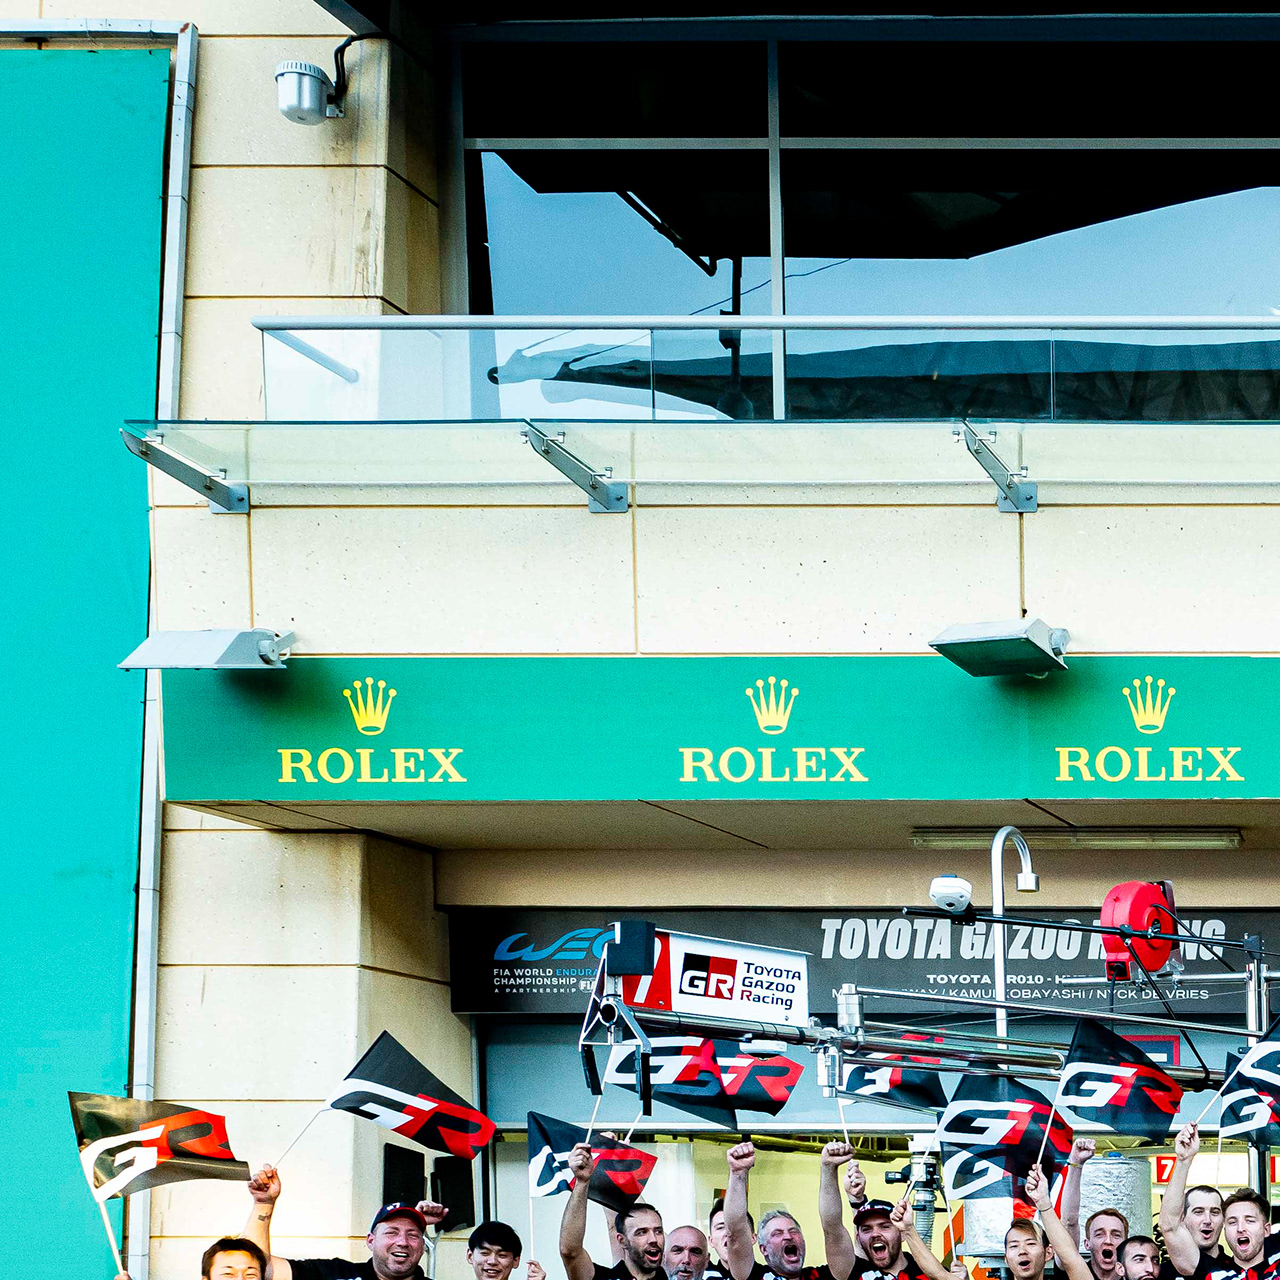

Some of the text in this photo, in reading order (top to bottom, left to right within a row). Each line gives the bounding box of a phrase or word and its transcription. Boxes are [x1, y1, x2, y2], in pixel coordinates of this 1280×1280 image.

[279, 748, 461, 783] ROLEX
[683, 748, 865, 783] ROLEX
[1057, 747, 1239, 782] ROLEX
[820, 918, 950, 960] TOYOTA
[744, 961, 801, 980] TOYOTA
[926, 974, 991, 985] TOYOTA
[494, 978, 577, 986] CHAMPIONSHIP
[680, 970, 735, 1000] GR
[742, 976, 795, 993] GAZOO
[740, 989, 793, 1010] Racing
[1006, 989, 1087, 1000] OBAYASHI
[1097, 990, 1139, 999] NYCK
[1165, 990, 1209, 999] VRIES
[1161, 1159, 1174, 1180] 7
